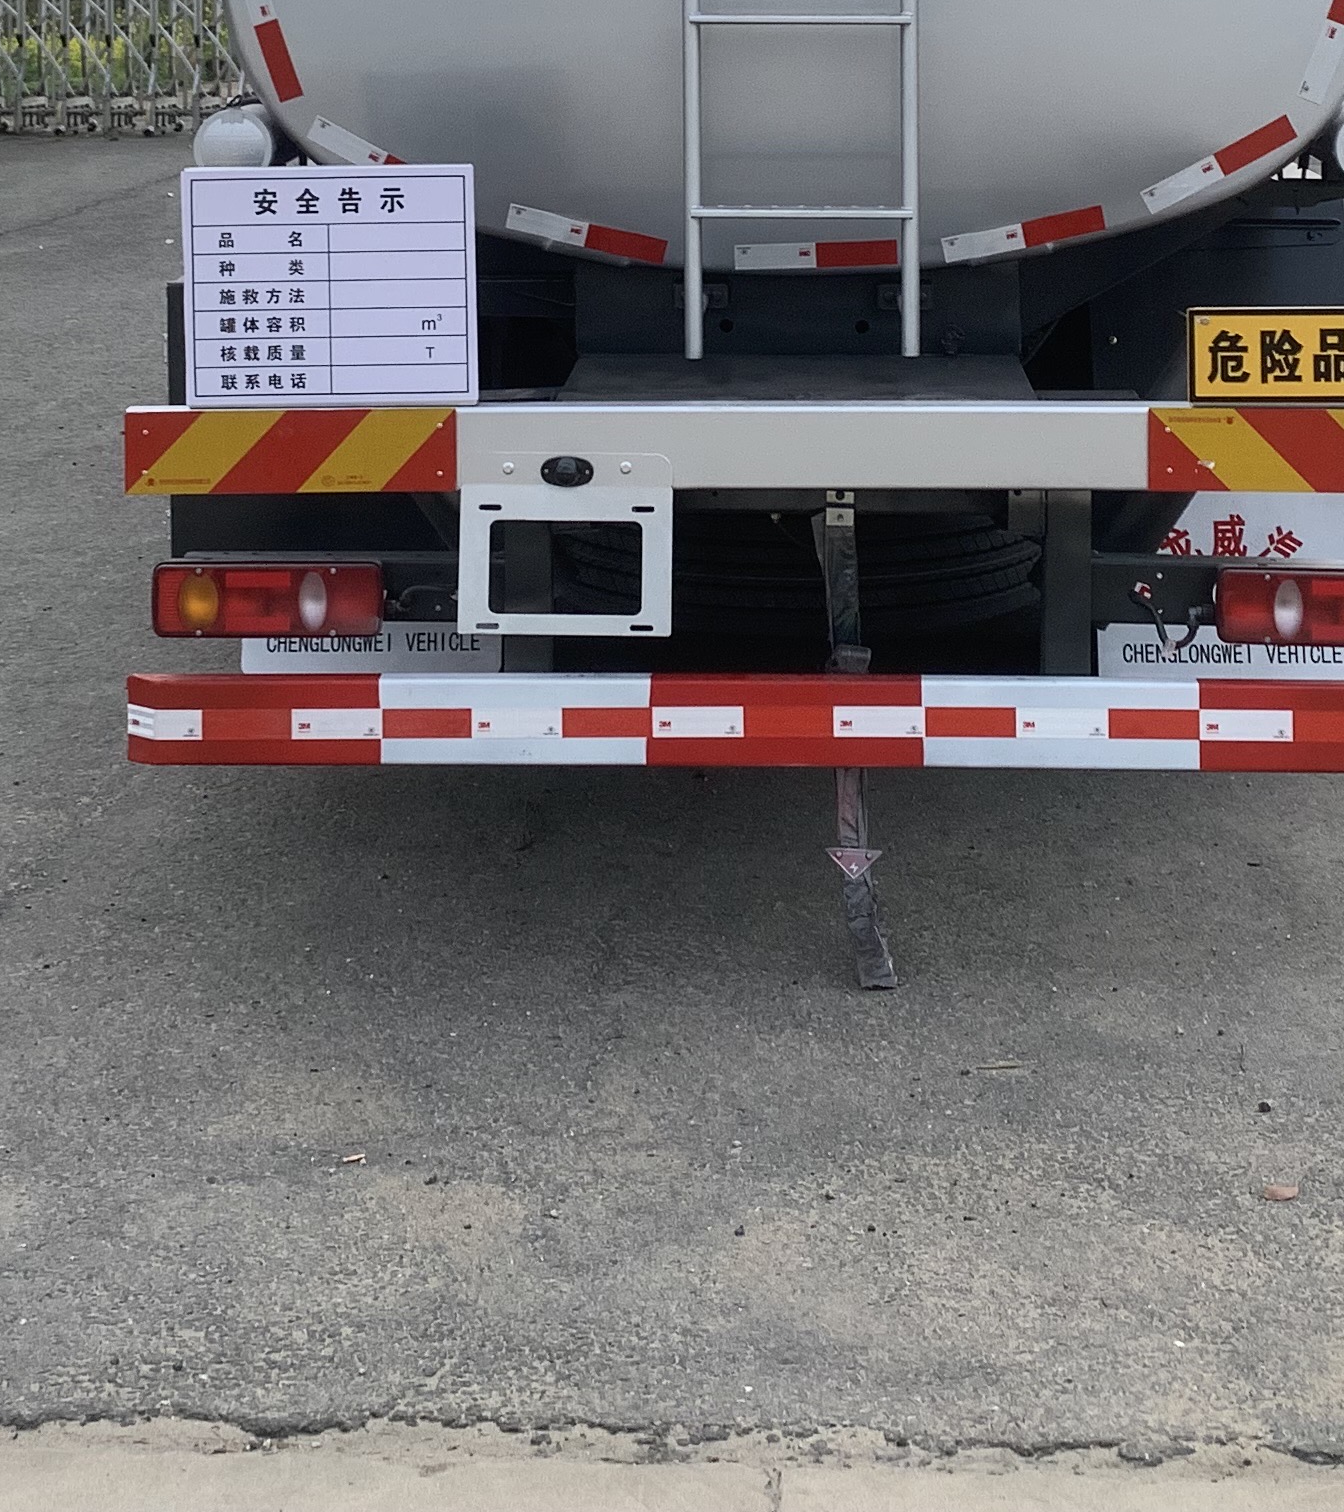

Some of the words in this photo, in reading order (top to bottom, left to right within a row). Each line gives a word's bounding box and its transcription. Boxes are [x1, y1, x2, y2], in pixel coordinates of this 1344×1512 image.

[253, 187, 405, 216] 安全告示
[219, 288, 306, 305] 施救方法
[219, 316, 306, 334] 罐体容积
[220, 345, 307, 362] 核载质量
[425, 346, 435, 359] T
[221, 373, 308, 390] 联系电话
[265, 633, 392, 653] CHENGLONGWEI
[405, 632, 481, 652] VEHICLE
[1264, 644, 1344, 664] VEHICLE
